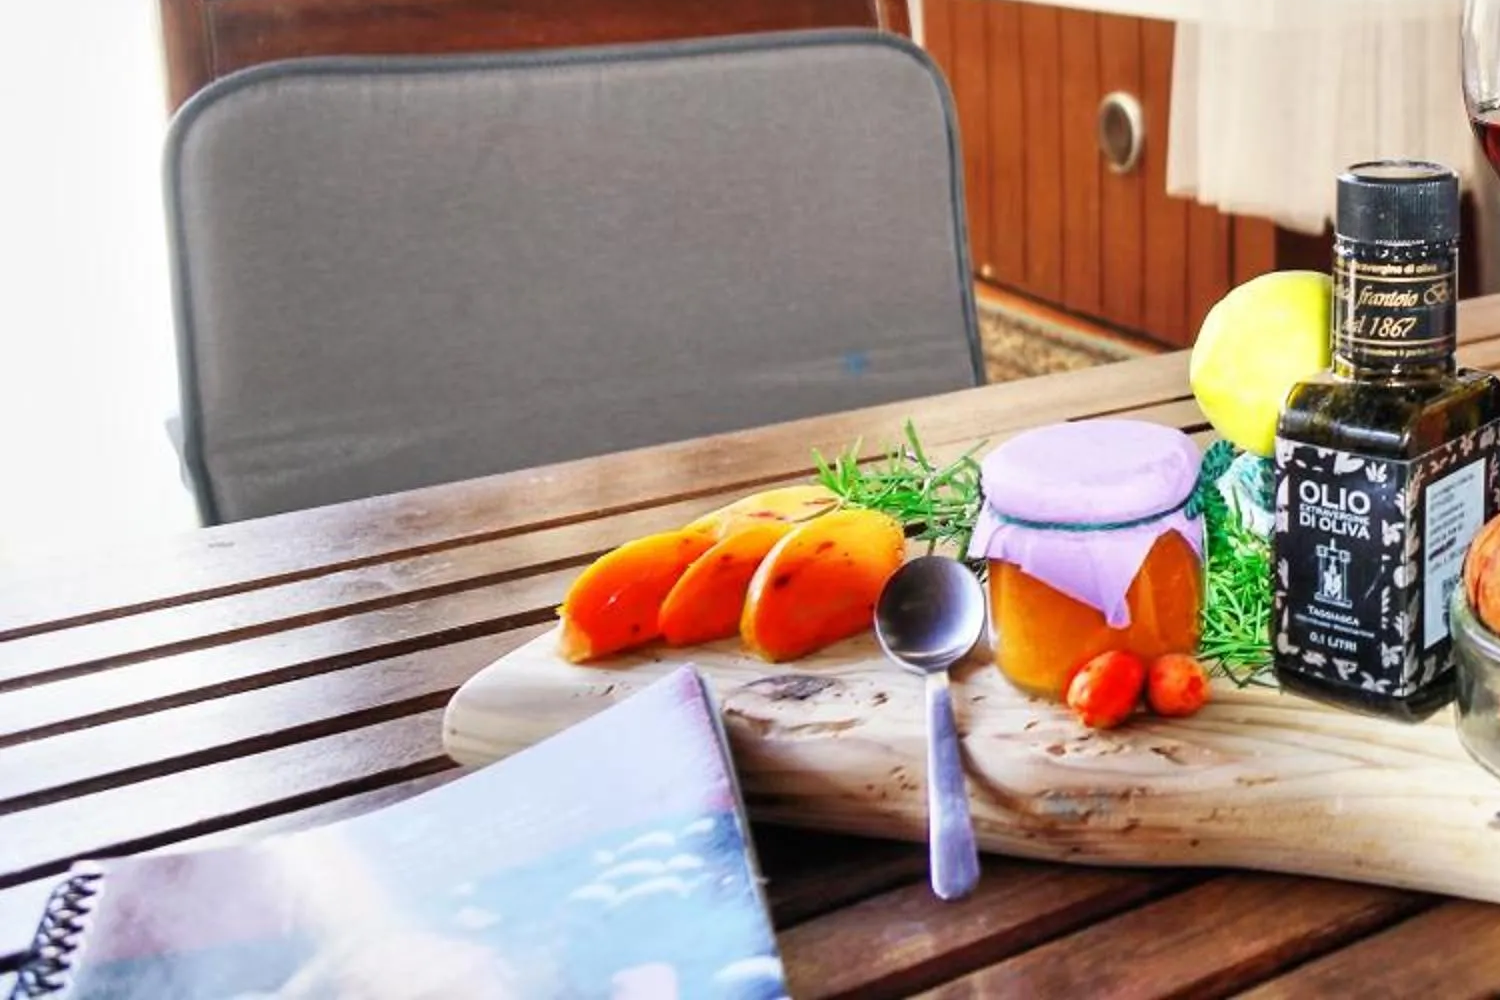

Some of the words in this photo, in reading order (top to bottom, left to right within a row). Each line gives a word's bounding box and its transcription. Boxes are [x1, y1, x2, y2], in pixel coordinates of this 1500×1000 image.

[1354, 285, 1419, 310] frantoio
[1369, 317, 1417, 338] 1867
[1299, 480, 1371, 515] OLIO
[1299, 511, 1316, 529] DI
[1319, 517, 1371, 540] OLIVA
[1327, 635, 1357, 653] LITRI
